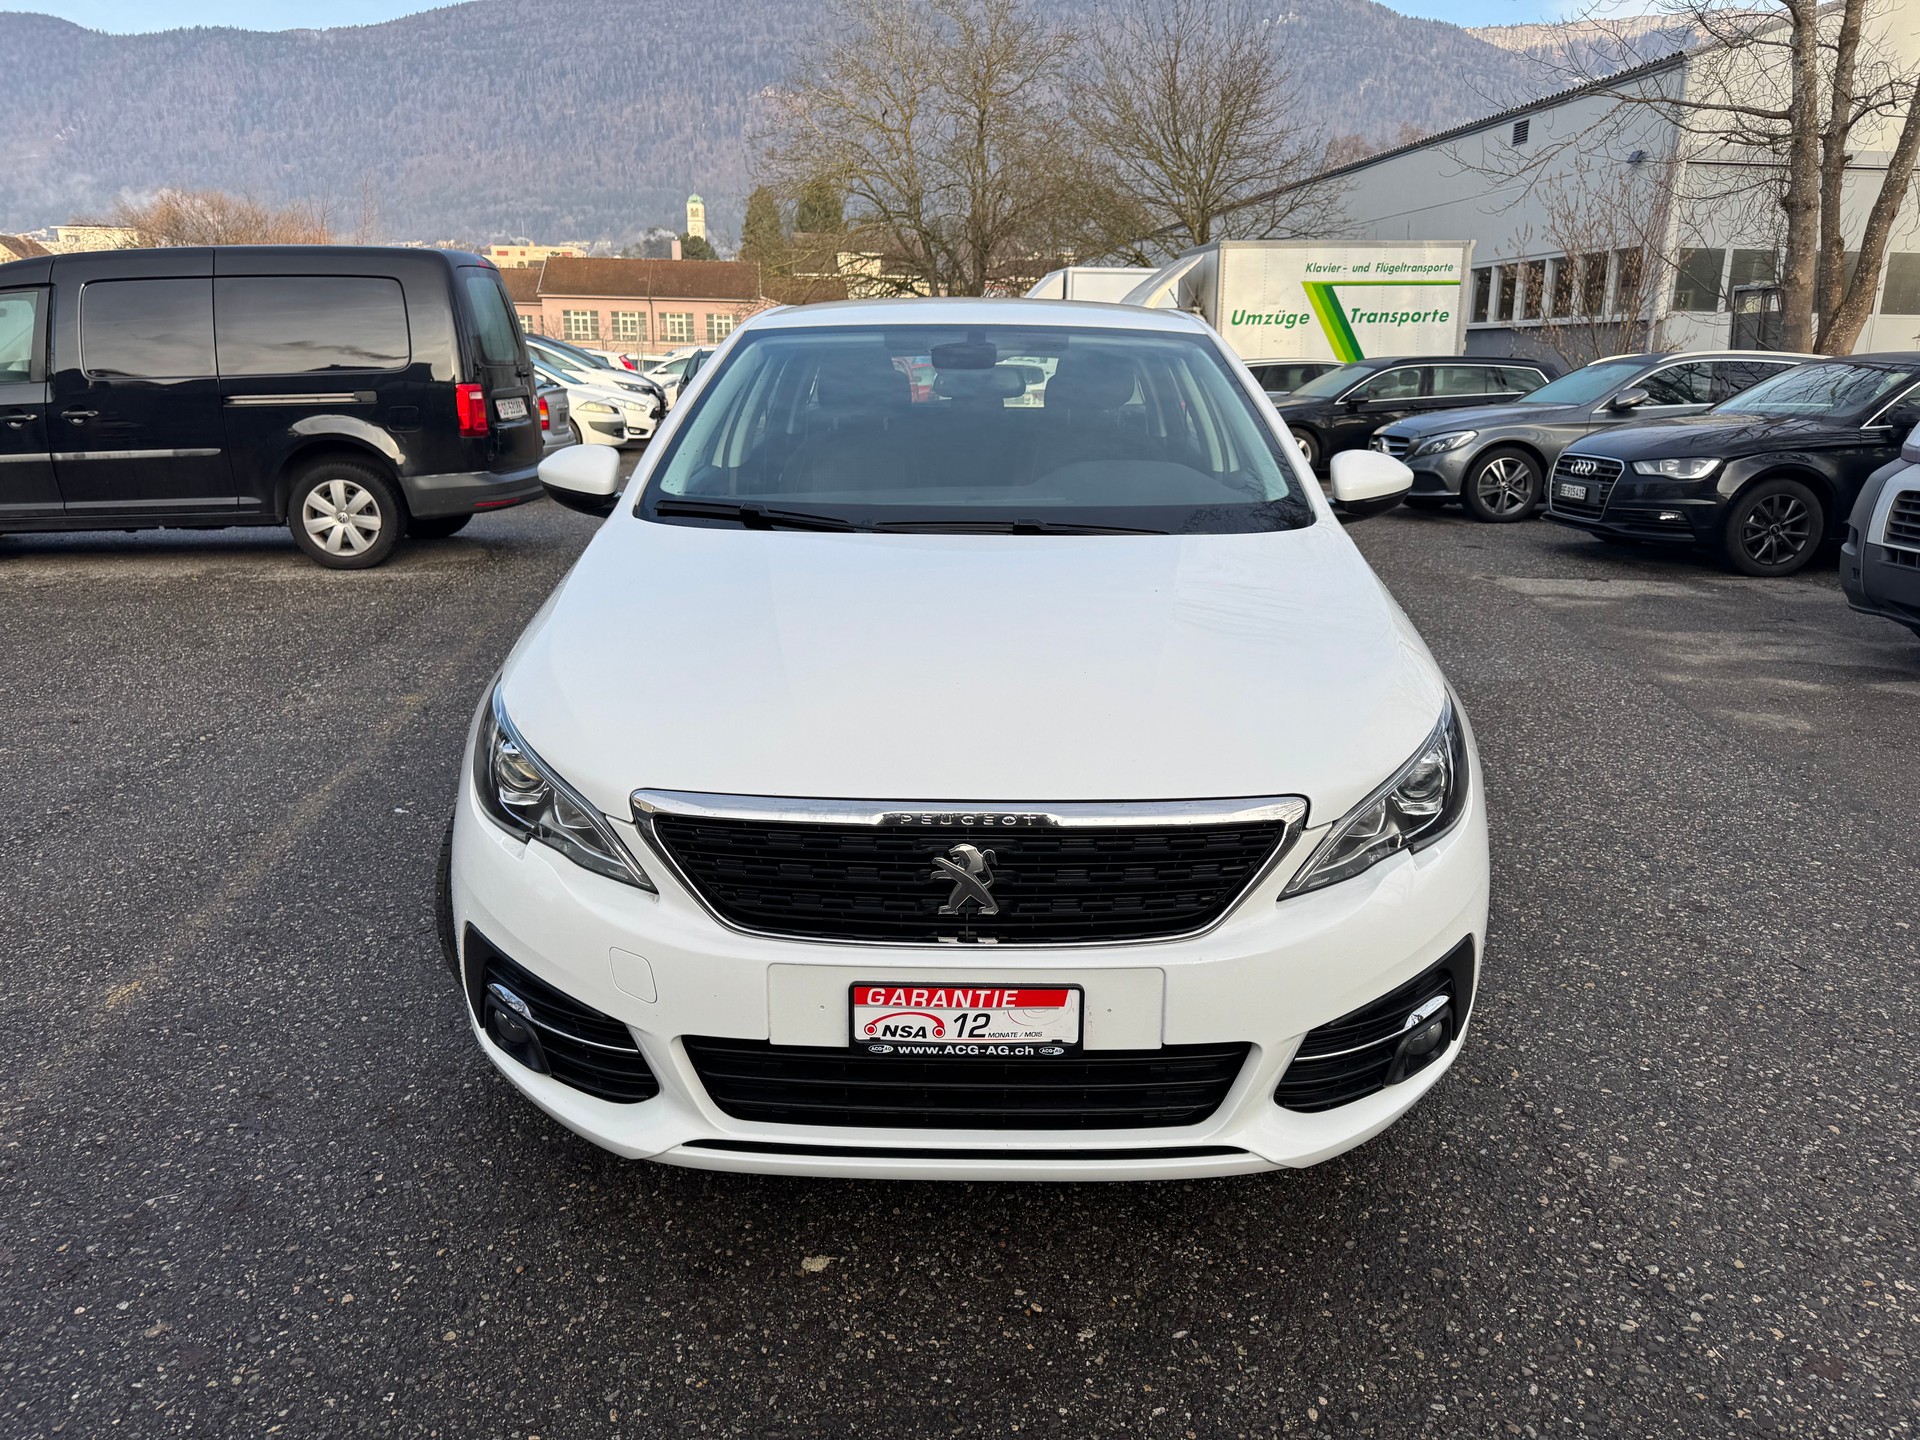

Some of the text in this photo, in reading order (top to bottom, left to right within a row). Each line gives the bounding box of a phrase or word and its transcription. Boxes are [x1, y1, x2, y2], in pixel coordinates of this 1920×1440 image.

[1305, 261, 1454, 275] Klavier- und Flügeltransporte
[1230, 309, 1310, 329] Umzüge
[1350, 307, 1450, 328] Transporte
[899, 813, 1037, 826] PEUGEOT
[867, 988, 1018, 1008] GARANTIE
[881, 1024, 927, 1039] NSA
[953, 1012, 991, 1039] 12
[898, 1044, 1034, 1056] www.ACG-AG.ch
